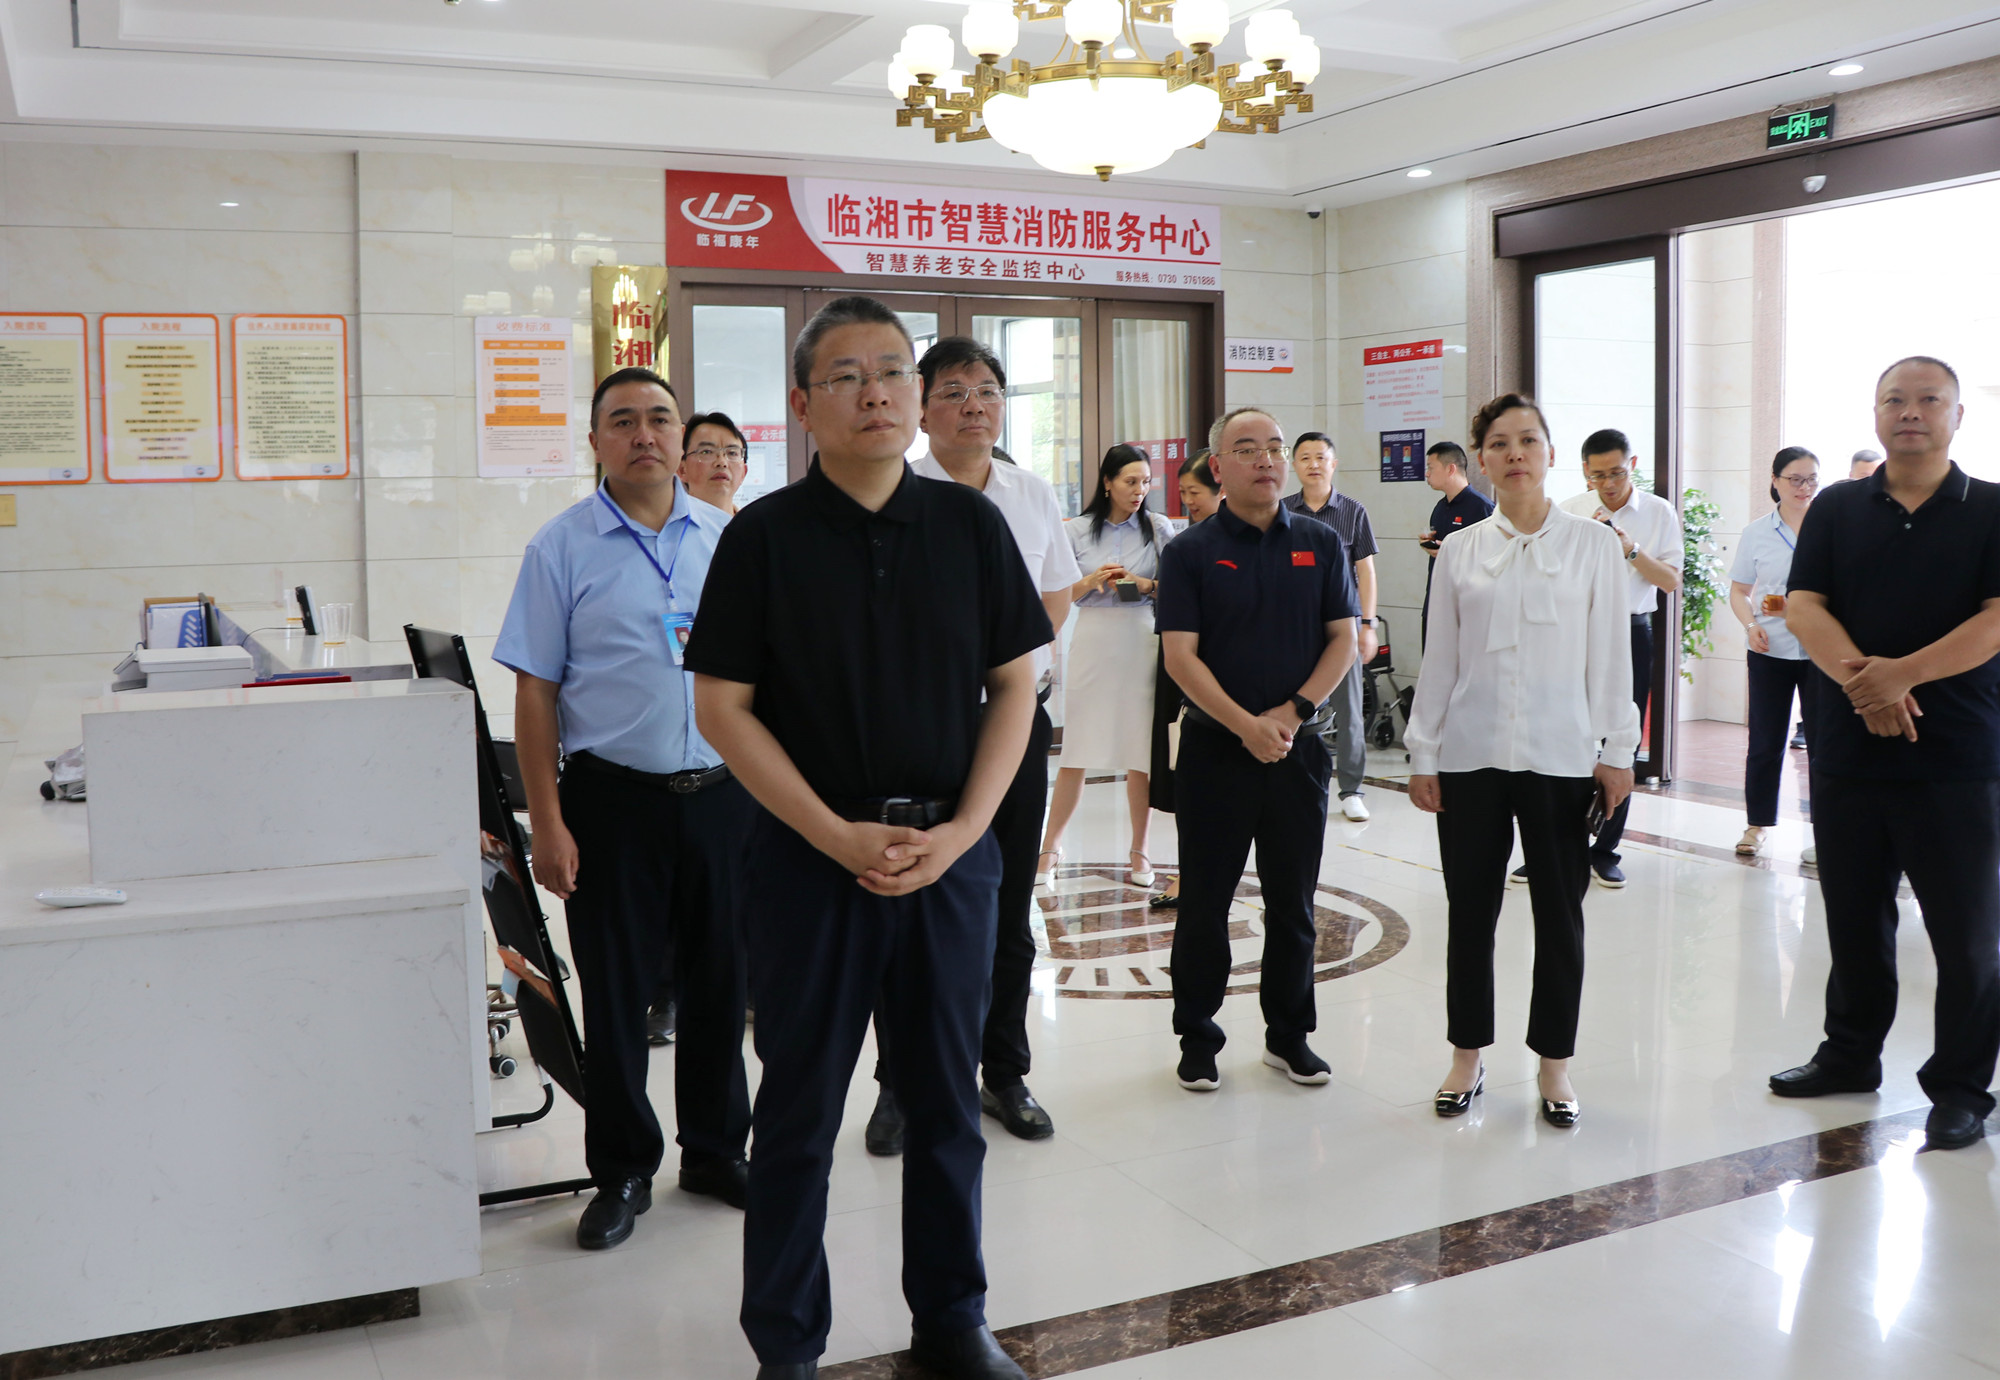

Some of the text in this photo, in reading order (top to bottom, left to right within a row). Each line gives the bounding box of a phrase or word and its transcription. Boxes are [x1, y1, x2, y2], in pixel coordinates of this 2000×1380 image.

[698, 192, 756, 220] LF
[828, 193, 1210, 256] 临湘市智慧消防服务中心
[866, 252, 1085, 281] 智慧养老安全监控中心
[1158, 273, 1177, 284] 0730
[496, 321, 552, 332] 收费标准
[613, 301, 652, 366] 临湘
[1229, 345, 1275, 360] 消防控制室
